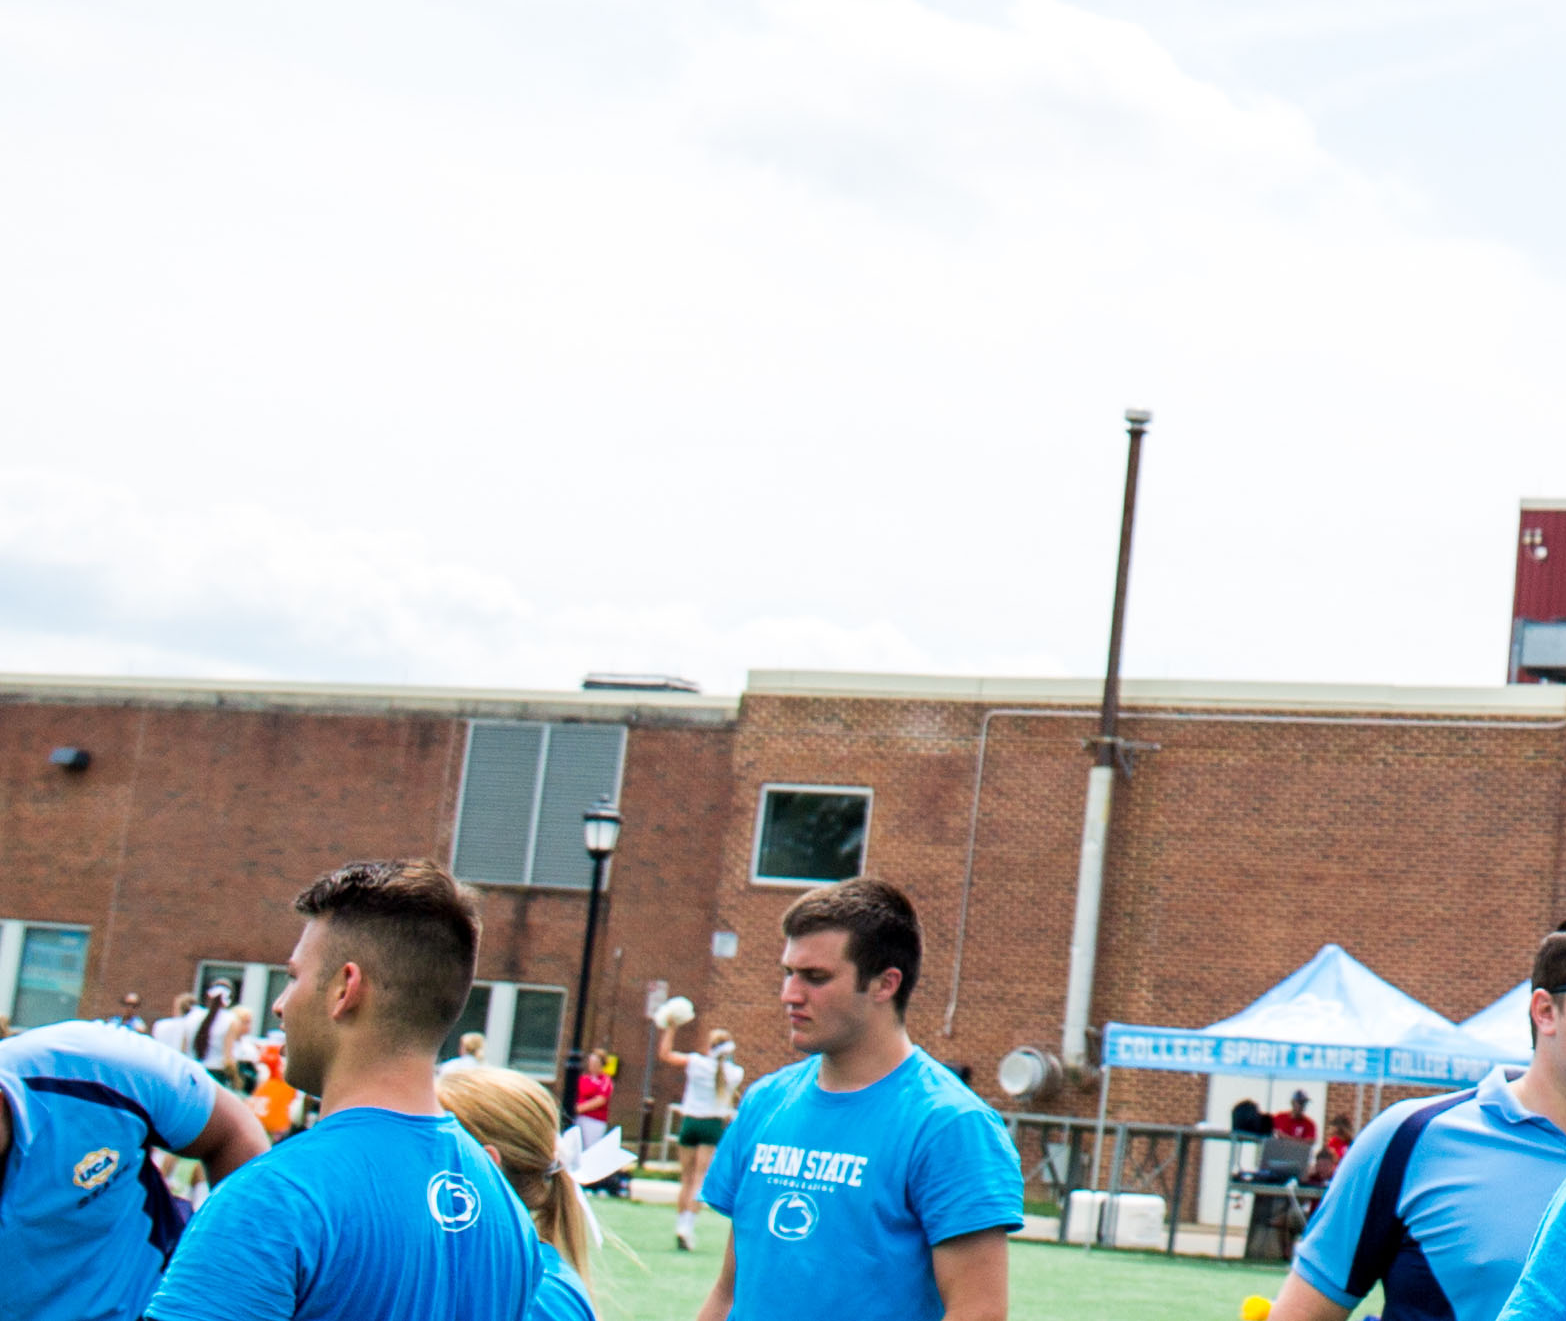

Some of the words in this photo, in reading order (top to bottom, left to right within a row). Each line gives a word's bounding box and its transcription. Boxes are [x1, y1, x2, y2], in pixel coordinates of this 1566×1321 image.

[1117, 1035, 1217, 1064] COLLEGE
[1219, 1039, 1290, 1068] SPIRIT
[1296, 1045, 1368, 1074] CAMPS
[80, 1156, 115, 1183] UCA
[750, 1142, 805, 1177] PENN
[803, 1150, 868, 1187] STATE
